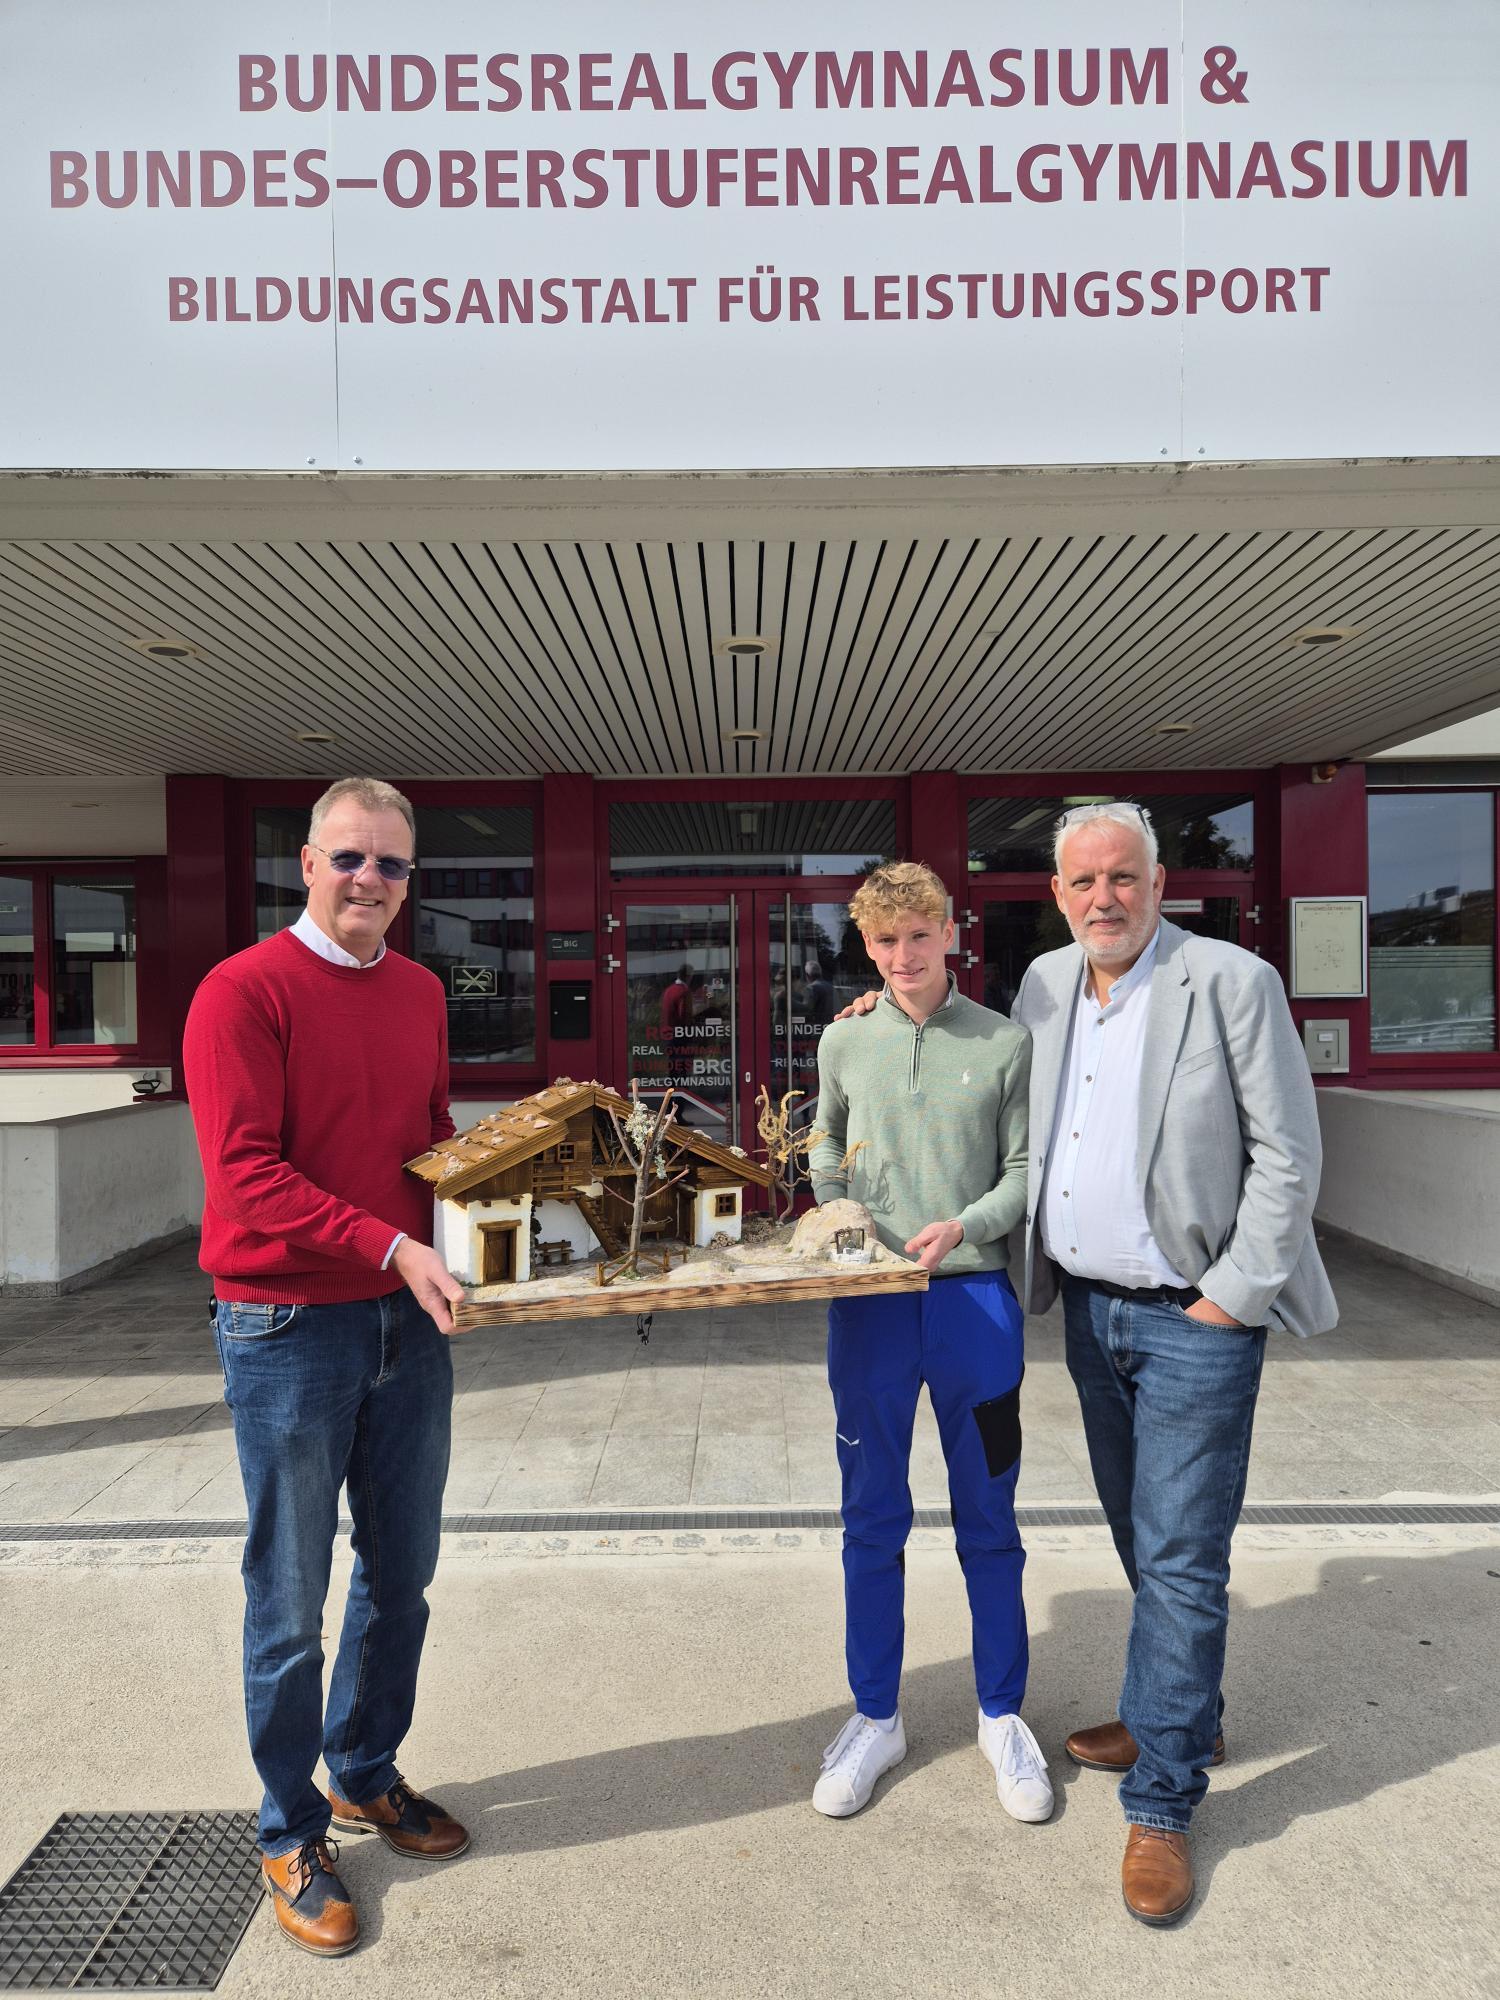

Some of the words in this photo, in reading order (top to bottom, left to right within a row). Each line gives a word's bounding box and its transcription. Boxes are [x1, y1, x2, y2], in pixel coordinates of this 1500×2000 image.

[238, 48, 1170, 112] BUNDESREALGYMNASIUM
[1199, 45, 1249, 105] &
[168, 276, 697, 324] BILDUNGSANSTALT
[719, 264, 821, 323] FÜR
[843, 266, 1331, 321] LEISTUNGSSPORT
